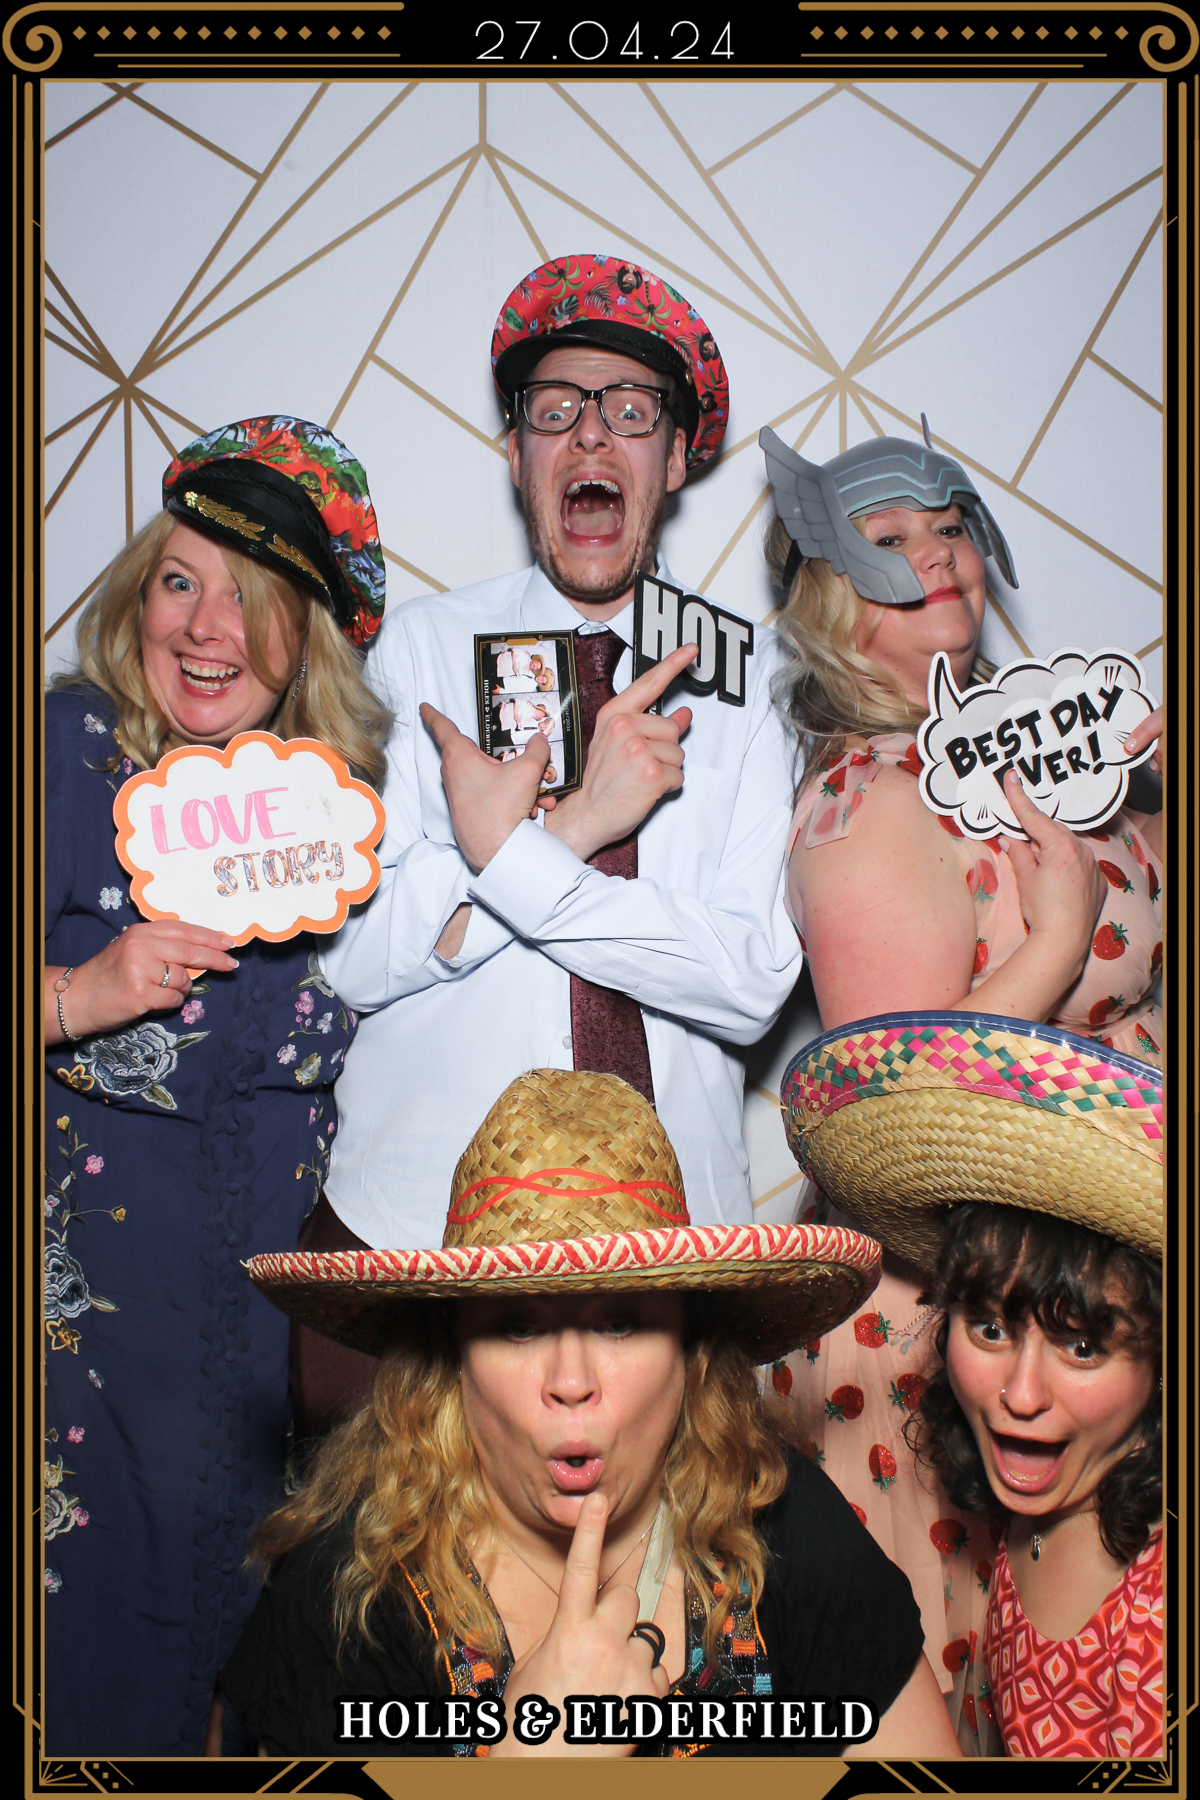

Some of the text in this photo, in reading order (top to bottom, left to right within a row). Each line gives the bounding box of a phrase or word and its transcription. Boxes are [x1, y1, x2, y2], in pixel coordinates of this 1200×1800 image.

[641, 578, 750, 698] HOT
[945, 684, 1124, 779] BEST DAY
[150, 787, 296, 854] LOVE
[213, 840, 345, 897] STORY
